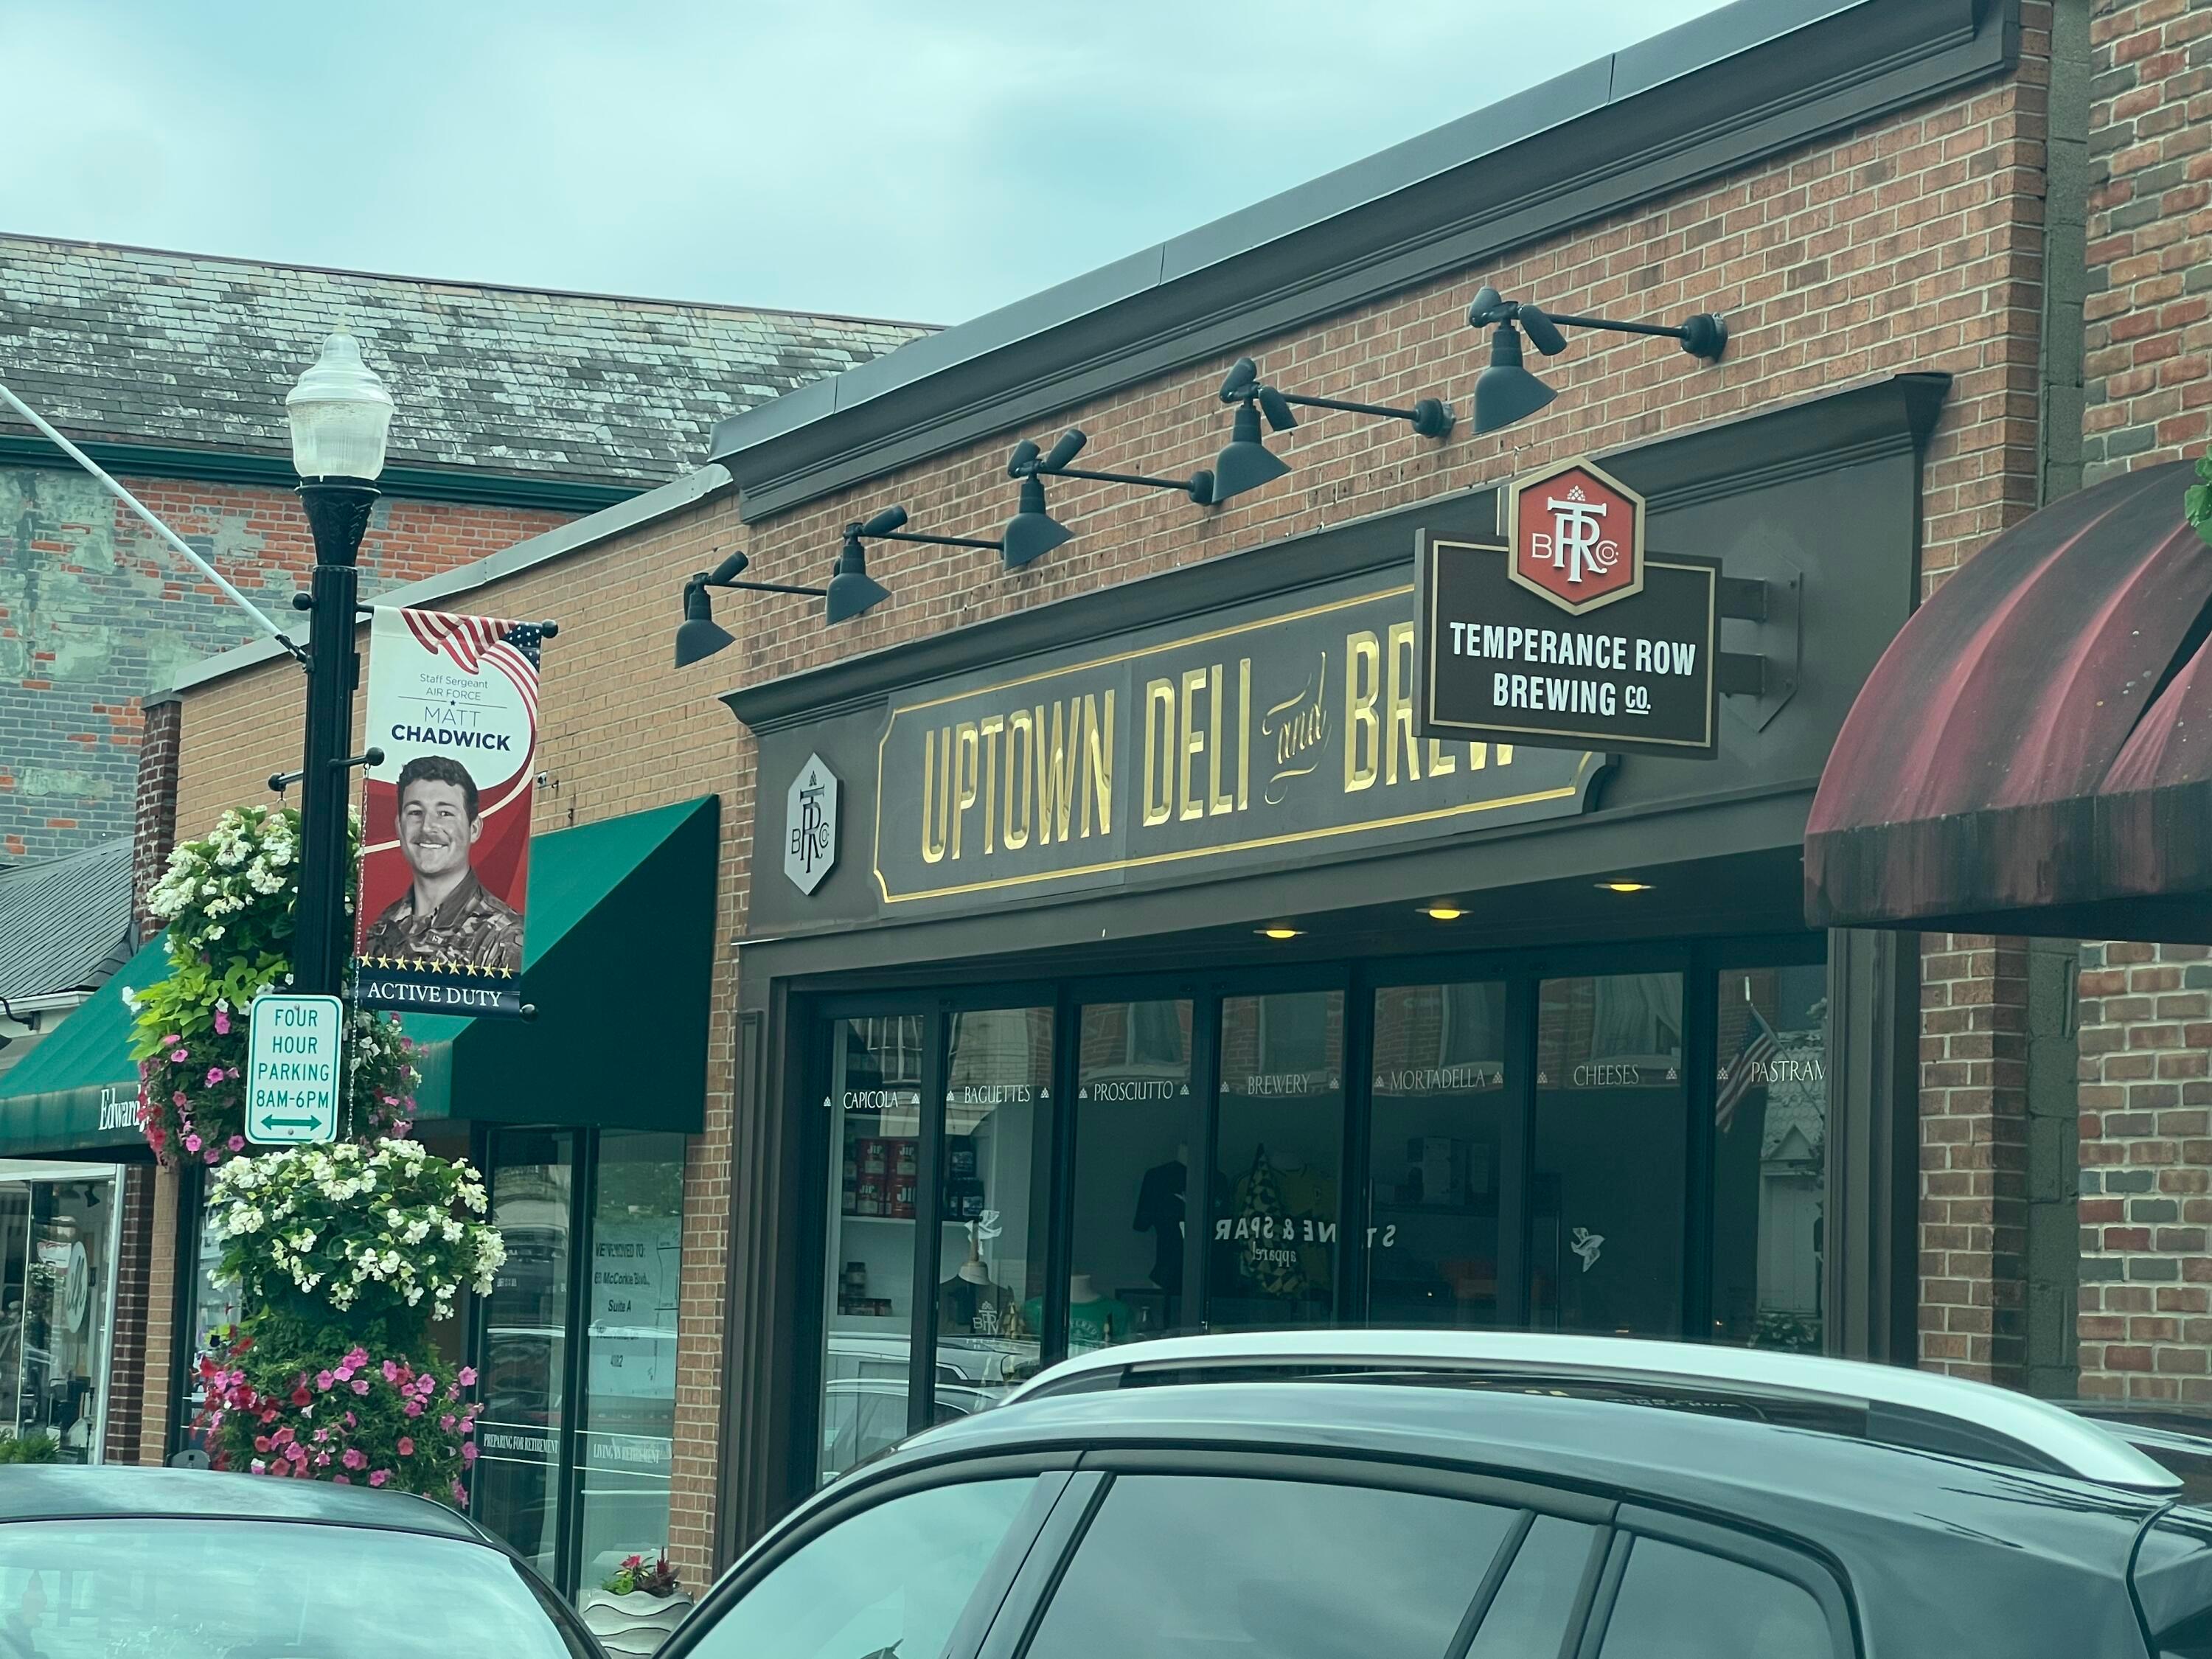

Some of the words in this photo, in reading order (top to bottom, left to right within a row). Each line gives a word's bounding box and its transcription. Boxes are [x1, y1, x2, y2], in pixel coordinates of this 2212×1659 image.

[1450, 622, 1627, 671] TEMPERANCE
[1635, 639, 1696, 676] ROW
[420, 673, 443, 684] Staff
[445, 675, 488, 689] Sergeant
[425, 686, 443, 698] AIR
[446, 689, 481, 701] FORCE
[1493, 672, 1616, 716] BREWING
[1625, 685, 1652, 714] CO.
[424, 706, 481, 728] MATT
[392, 724, 511, 751] CHADWICK
[922, 689, 1115, 863] UPTOWN
[1143, 658, 1251, 827] DELI
[1344, 621, 1514, 793] BR
[367, 981, 441, 1004] ACTIVE
[445, 987, 502, 1008] DUTY
[274, 1009, 317, 1027] FOUR
[272, 1036, 317, 1054] HOUR
[258, 1062, 330, 1082] PARKING
[1390, 1068, 1486, 1091] MORTADELLA
[1573, 1064, 1640, 1086] CHEESES
[964, 1084, 1031, 1104] BAGUETTES
[1093, 1080, 1174, 1102] PROSCIUTTO
[1248, 1074, 1311, 1096] BREWERY
[256, 1090, 329, 1108] 8AM-6PM
[843, 1091, 898, 1109] CAPICOLA
[483, 1433, 513, 1451] PREPARING
[512, 1435, 525, 1452] FOR
[524, 1437, 560, 1454] RETIREMENT
[594, 1443, 614, 1459] LIVING
